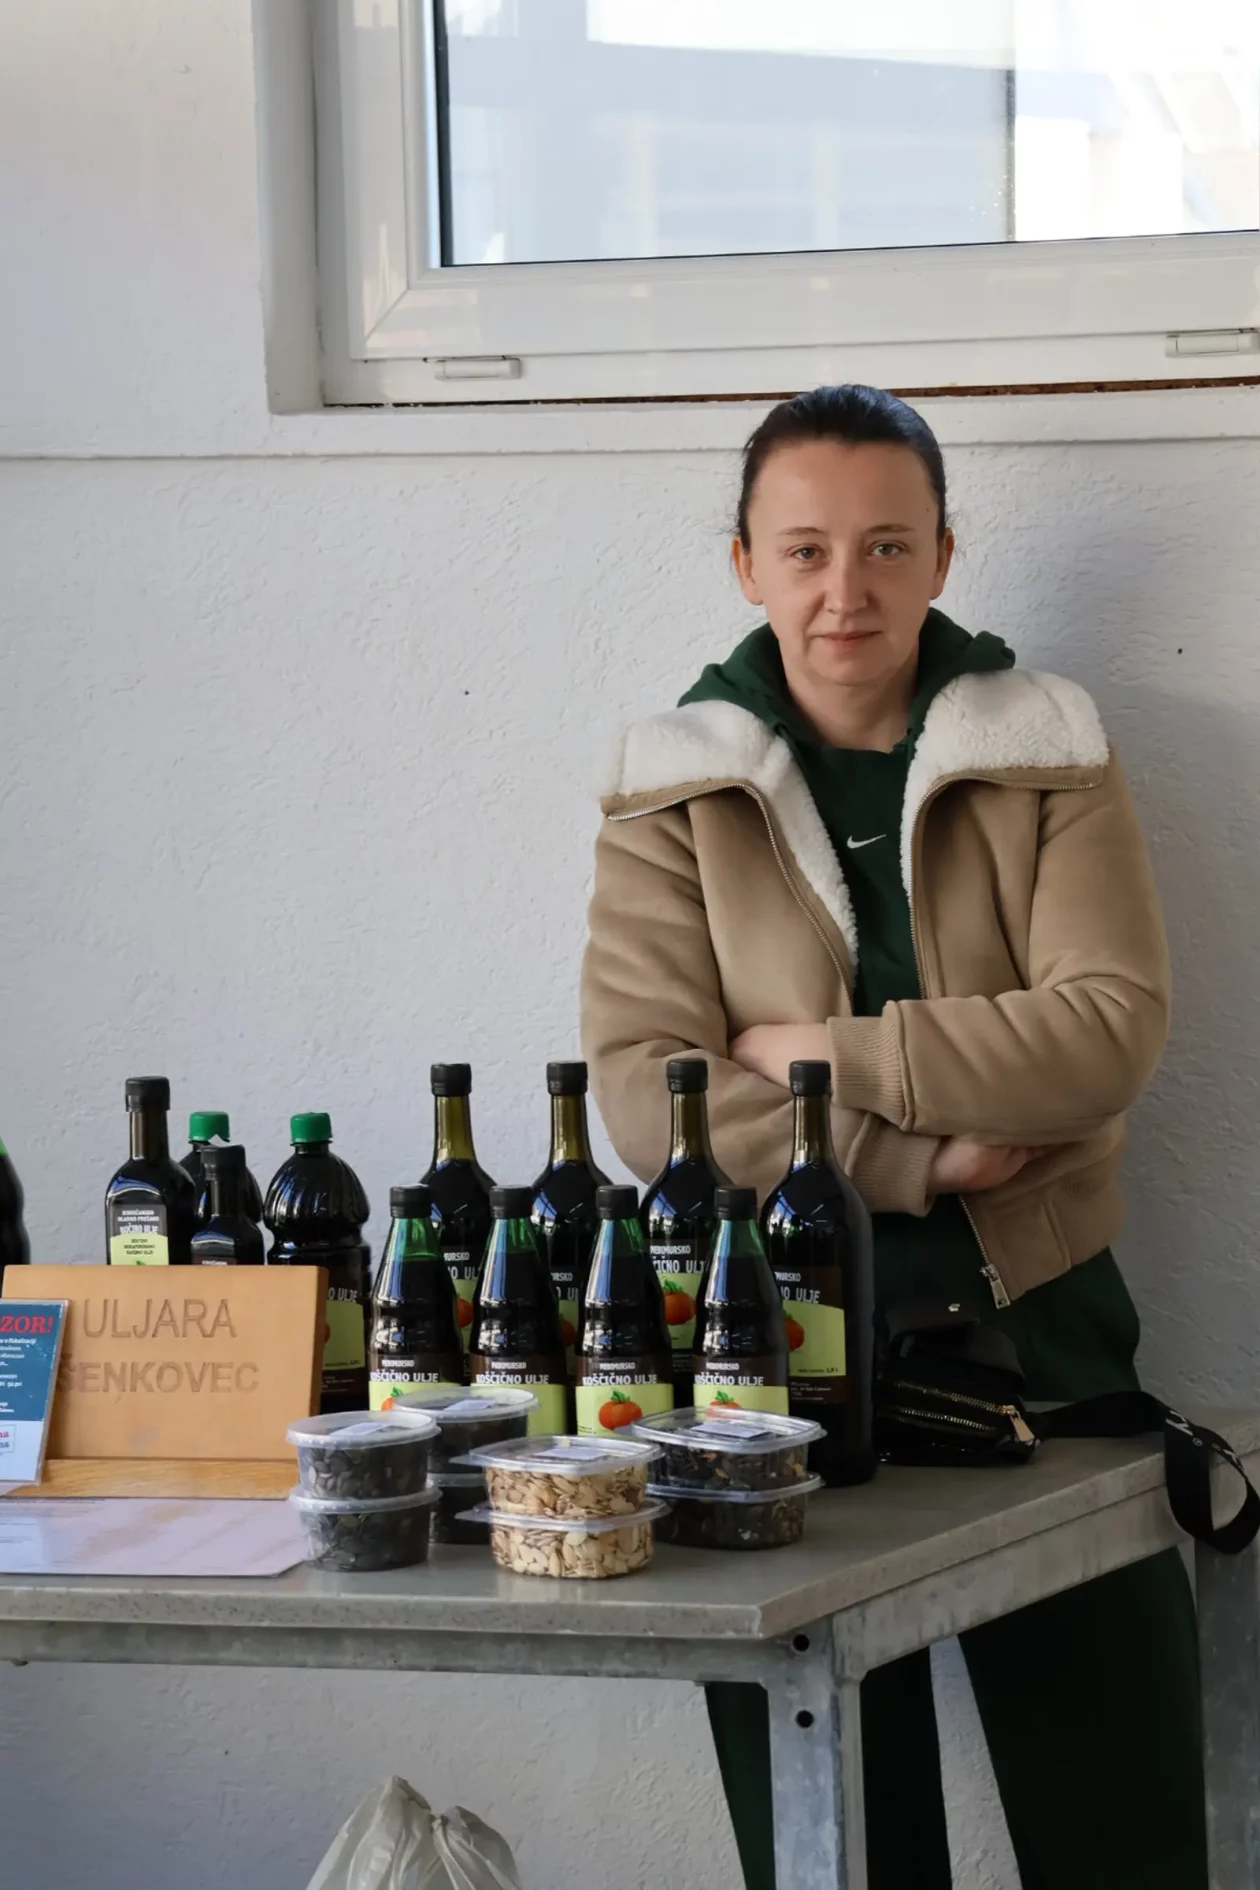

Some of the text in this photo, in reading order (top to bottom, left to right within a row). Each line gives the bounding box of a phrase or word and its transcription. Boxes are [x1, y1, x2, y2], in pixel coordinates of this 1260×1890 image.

[796, 1287, 821, 1304] ULJE
[83, 1298, 238, 1338] ULJARA
[412, 1373, 439, 1382] ULJE
[524, 1374, 550, 1384] ULJE
[634, 1374, 658, 1384] ULJE
[738, 1375, 765, 1385] ULJE
